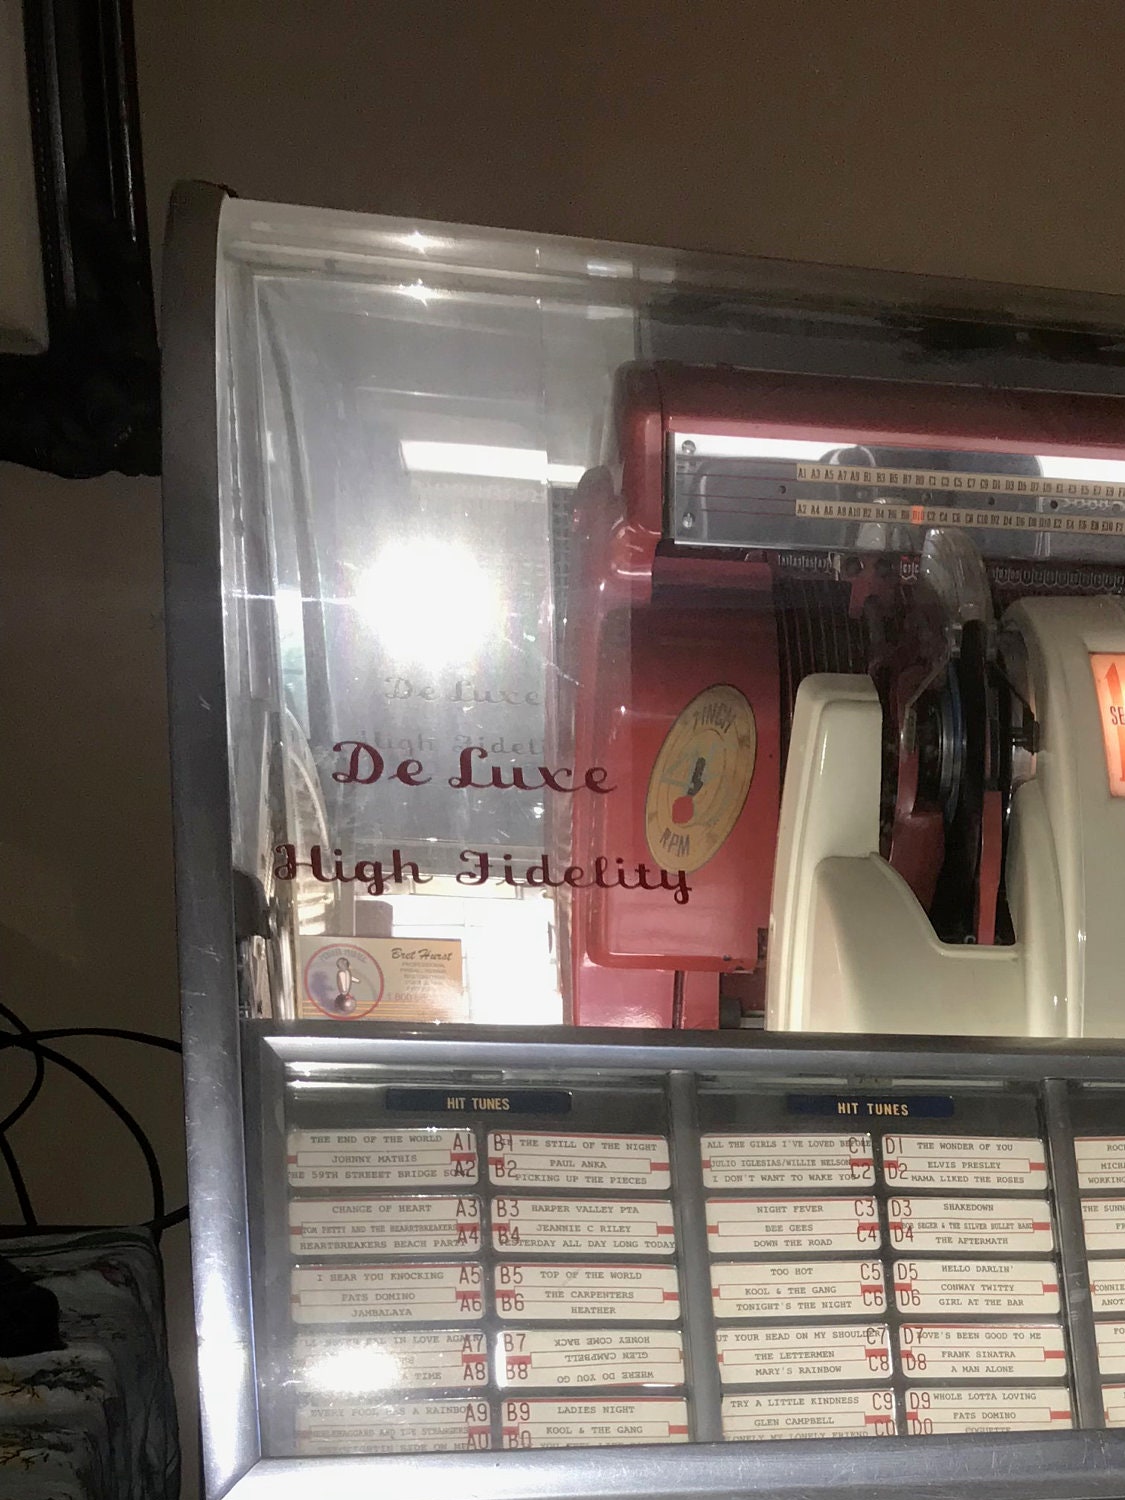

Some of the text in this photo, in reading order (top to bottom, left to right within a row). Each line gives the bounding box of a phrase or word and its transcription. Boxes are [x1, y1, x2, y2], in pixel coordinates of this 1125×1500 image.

[331, 739, 432, 786] De
[448, 746, 617, 794] Luxe
[274, 844, 692, 905] High Fidelity
[391, 947, 416, 960] Bret
[447, 1096, 511, 1111] HIT TUNES
[838, 1102, 909, 1117] HIT TUNES
[337, 1135, 358, 1144] END
[363, 1134, 378, 1144] OF
[383, 1134, 404, 1143] THE
[409, 1134, 443, 1143] WORLD
[549, 1159, 607, 1169] PAUL ANKA
[927, 1161, 1002, 1170] ELVIS PRESLEY
[455, 1199, 479, 1217] A3
[497, 1200, 520, 1218] B3
[575, 1204, 614, 1214] VALLEY
[620, 1205, 640, 1214] PTA
[757, 1205, 823, 1214] NIGHT FEVER
[854, 1199, 876, 1217] C3
[536, 1224, 581, 1233] JEANNIE
[599, 1224, 632, 1233] RILEY
[765, 1223, 813, 1232] BEE GEES
[898, 1263, 919, 1280] D5
[942, 1265, 971, 1273] HELLO
[545, 1290, 634, 1299] THE CARPENTERS
[754, 1350, 835, 1360] THE LETTERMEN
[942, 1350, 1016, 1359] FRANK SINATRA
[933, 1392, 1037, 1401] WHOLE LOTTA LOVING
[557, 1405, 635, 1415] LADIES NIGHT
